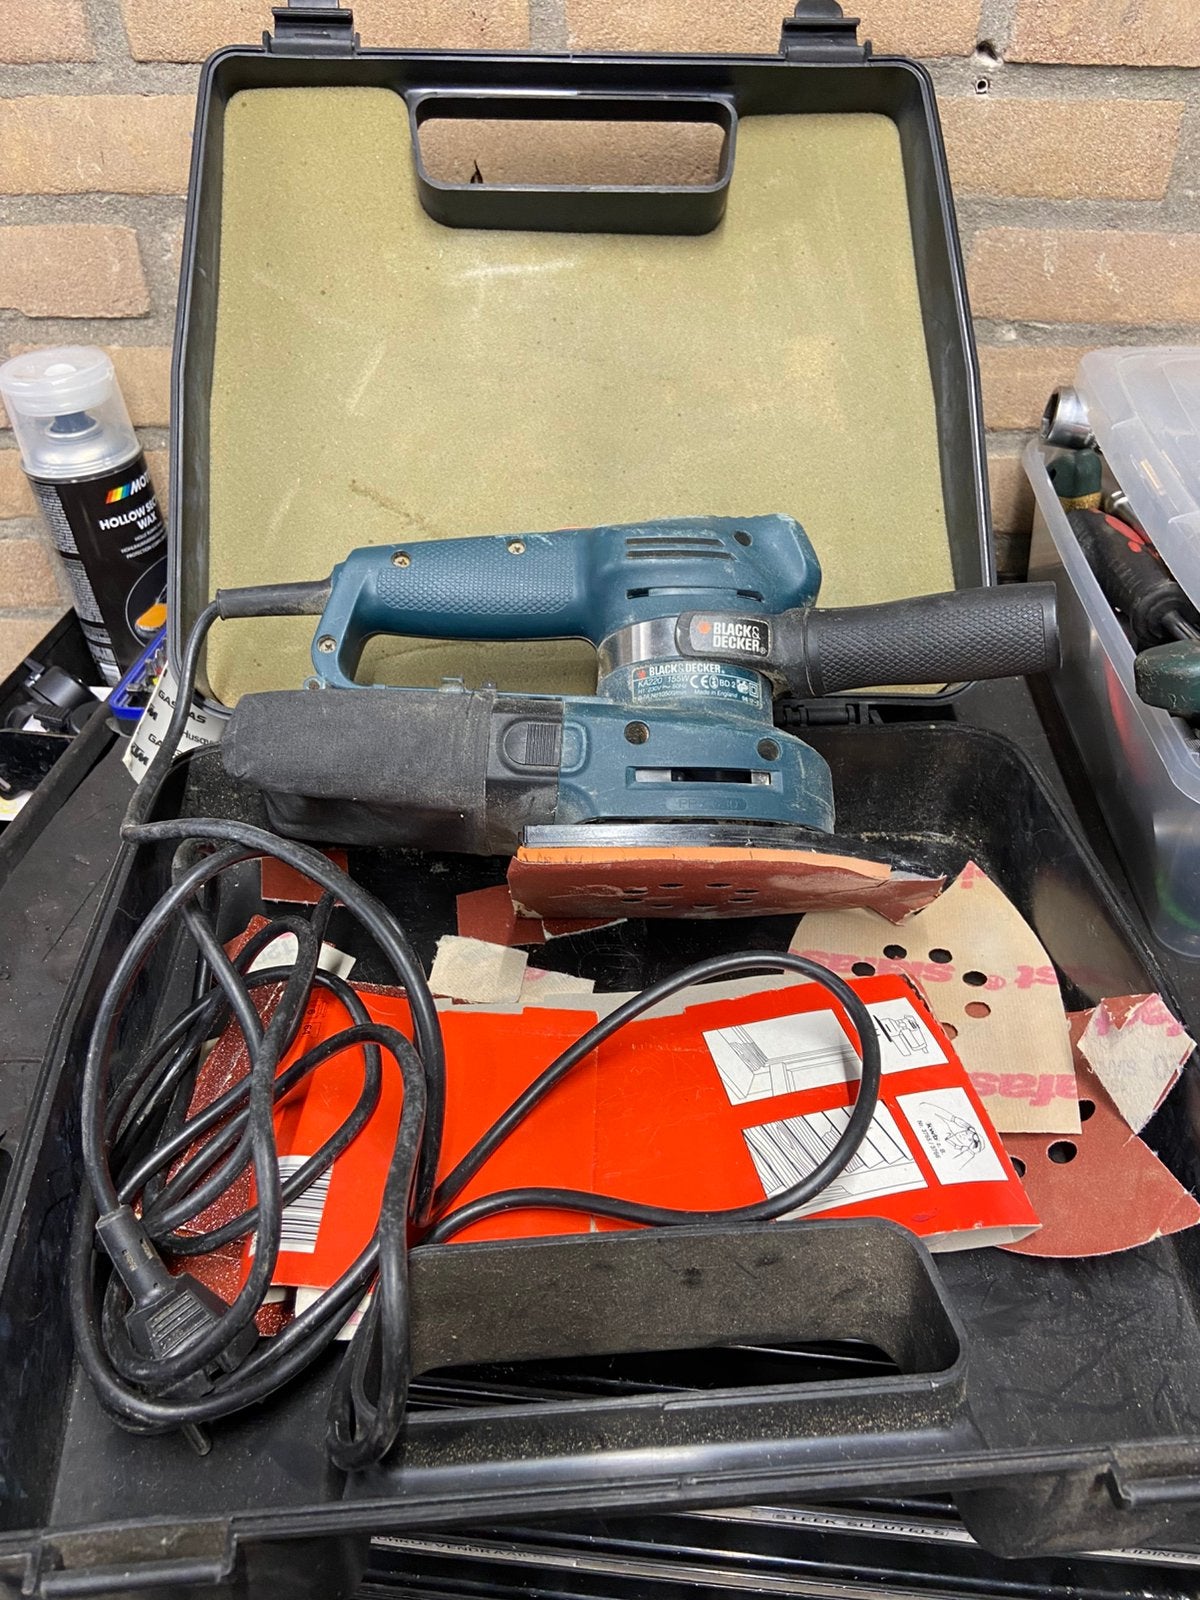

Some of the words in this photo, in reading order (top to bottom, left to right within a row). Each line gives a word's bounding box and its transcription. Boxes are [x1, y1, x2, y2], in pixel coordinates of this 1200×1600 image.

[130, 471, 150, 496] MOT
[99, 505, 146, 531] HOLLOW
[145, 495, 158, 513] SEC
[137, 511, 157, 530] WAX
[713, 622, 760, 640] BLACK&
[713, 635, 760, 652] DECKER
[130, 742, 150, 766] KTM
